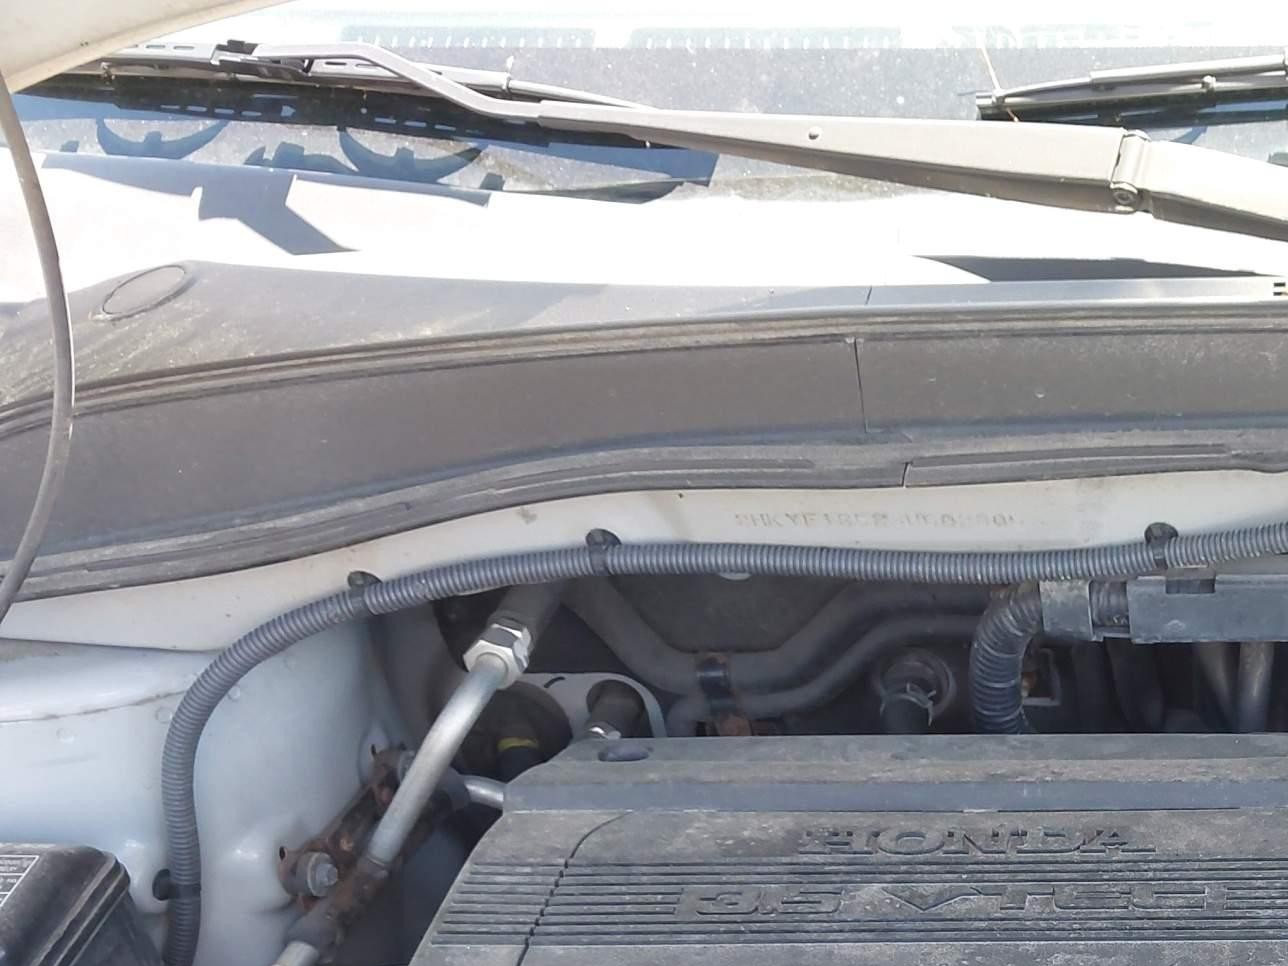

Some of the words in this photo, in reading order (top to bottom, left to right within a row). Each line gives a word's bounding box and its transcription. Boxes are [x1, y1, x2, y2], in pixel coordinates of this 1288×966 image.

[799, 829, 1157, 856] HONDA
[688, 883, 847, 915] 3.5
[879, 883, 1208, 915] VTEC
